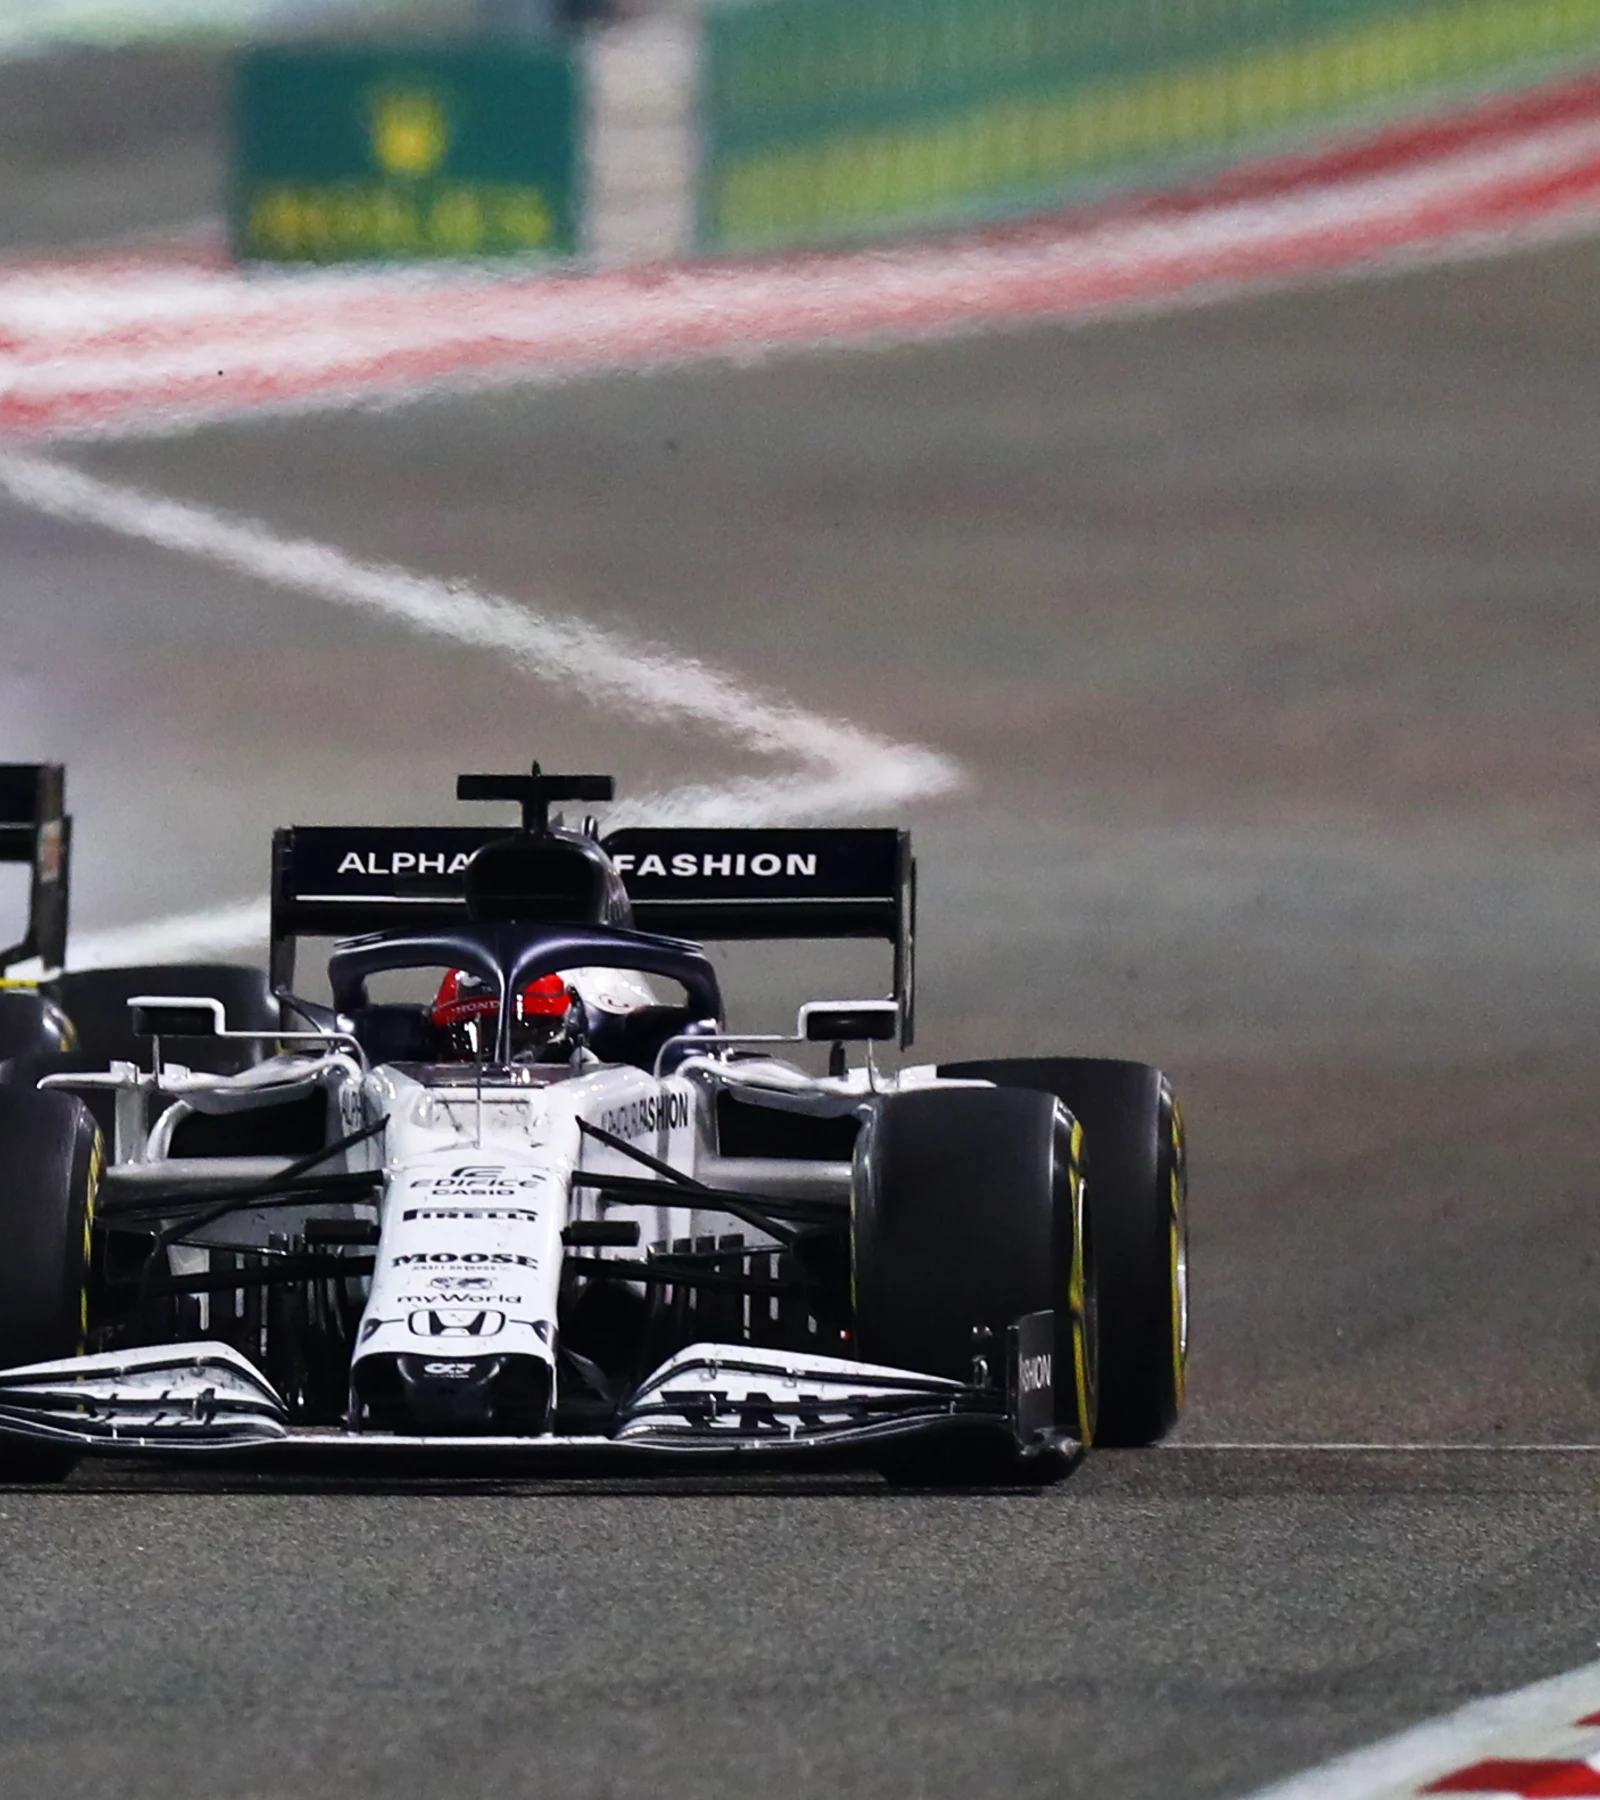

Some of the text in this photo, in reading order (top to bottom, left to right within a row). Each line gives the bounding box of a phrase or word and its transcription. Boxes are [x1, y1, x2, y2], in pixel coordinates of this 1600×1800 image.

[615, 853, 818, 876] FASHION
[410, 1178, 541, 1189] EDIFICE
[431, 1188, 516, 1196] CASIO
[402, 1207, 539, 1222] PIRELLI
[391, 1252, 539, 1271] MOOSE
[396, 1293, 523, 1305] myWorld
